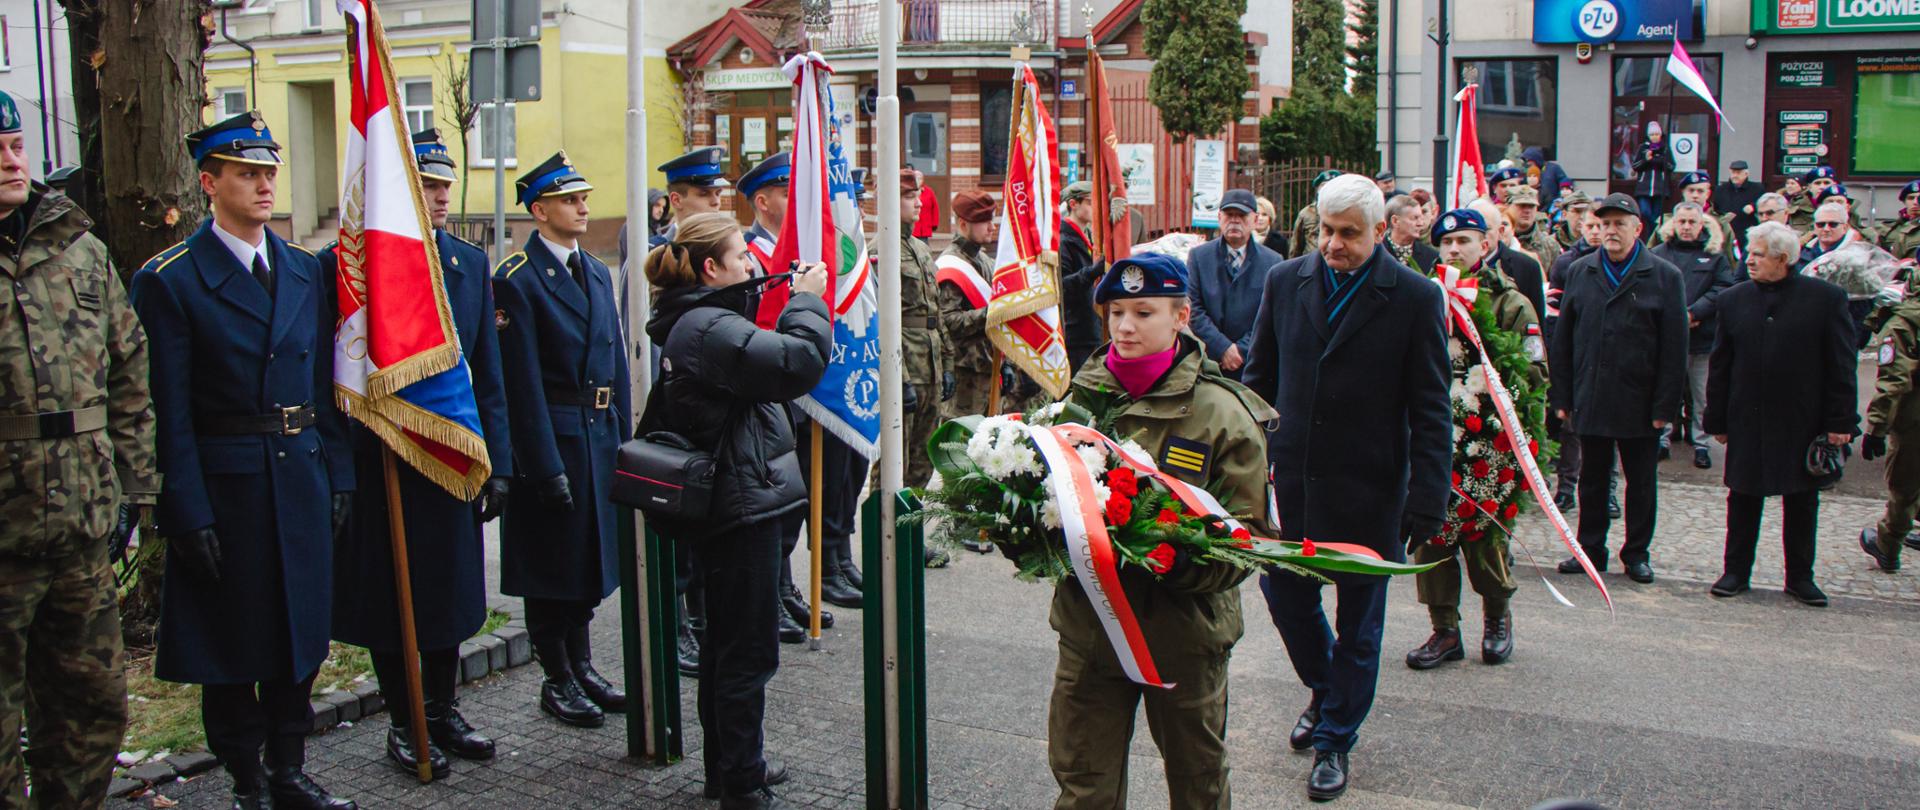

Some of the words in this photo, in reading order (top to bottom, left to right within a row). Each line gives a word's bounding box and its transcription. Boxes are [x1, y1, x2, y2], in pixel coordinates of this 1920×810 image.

[1584, 7, 1613, 29] PZU
[1637, 24, 1672, 37] Agent
[706, 74, 733, 84] SKLEP
